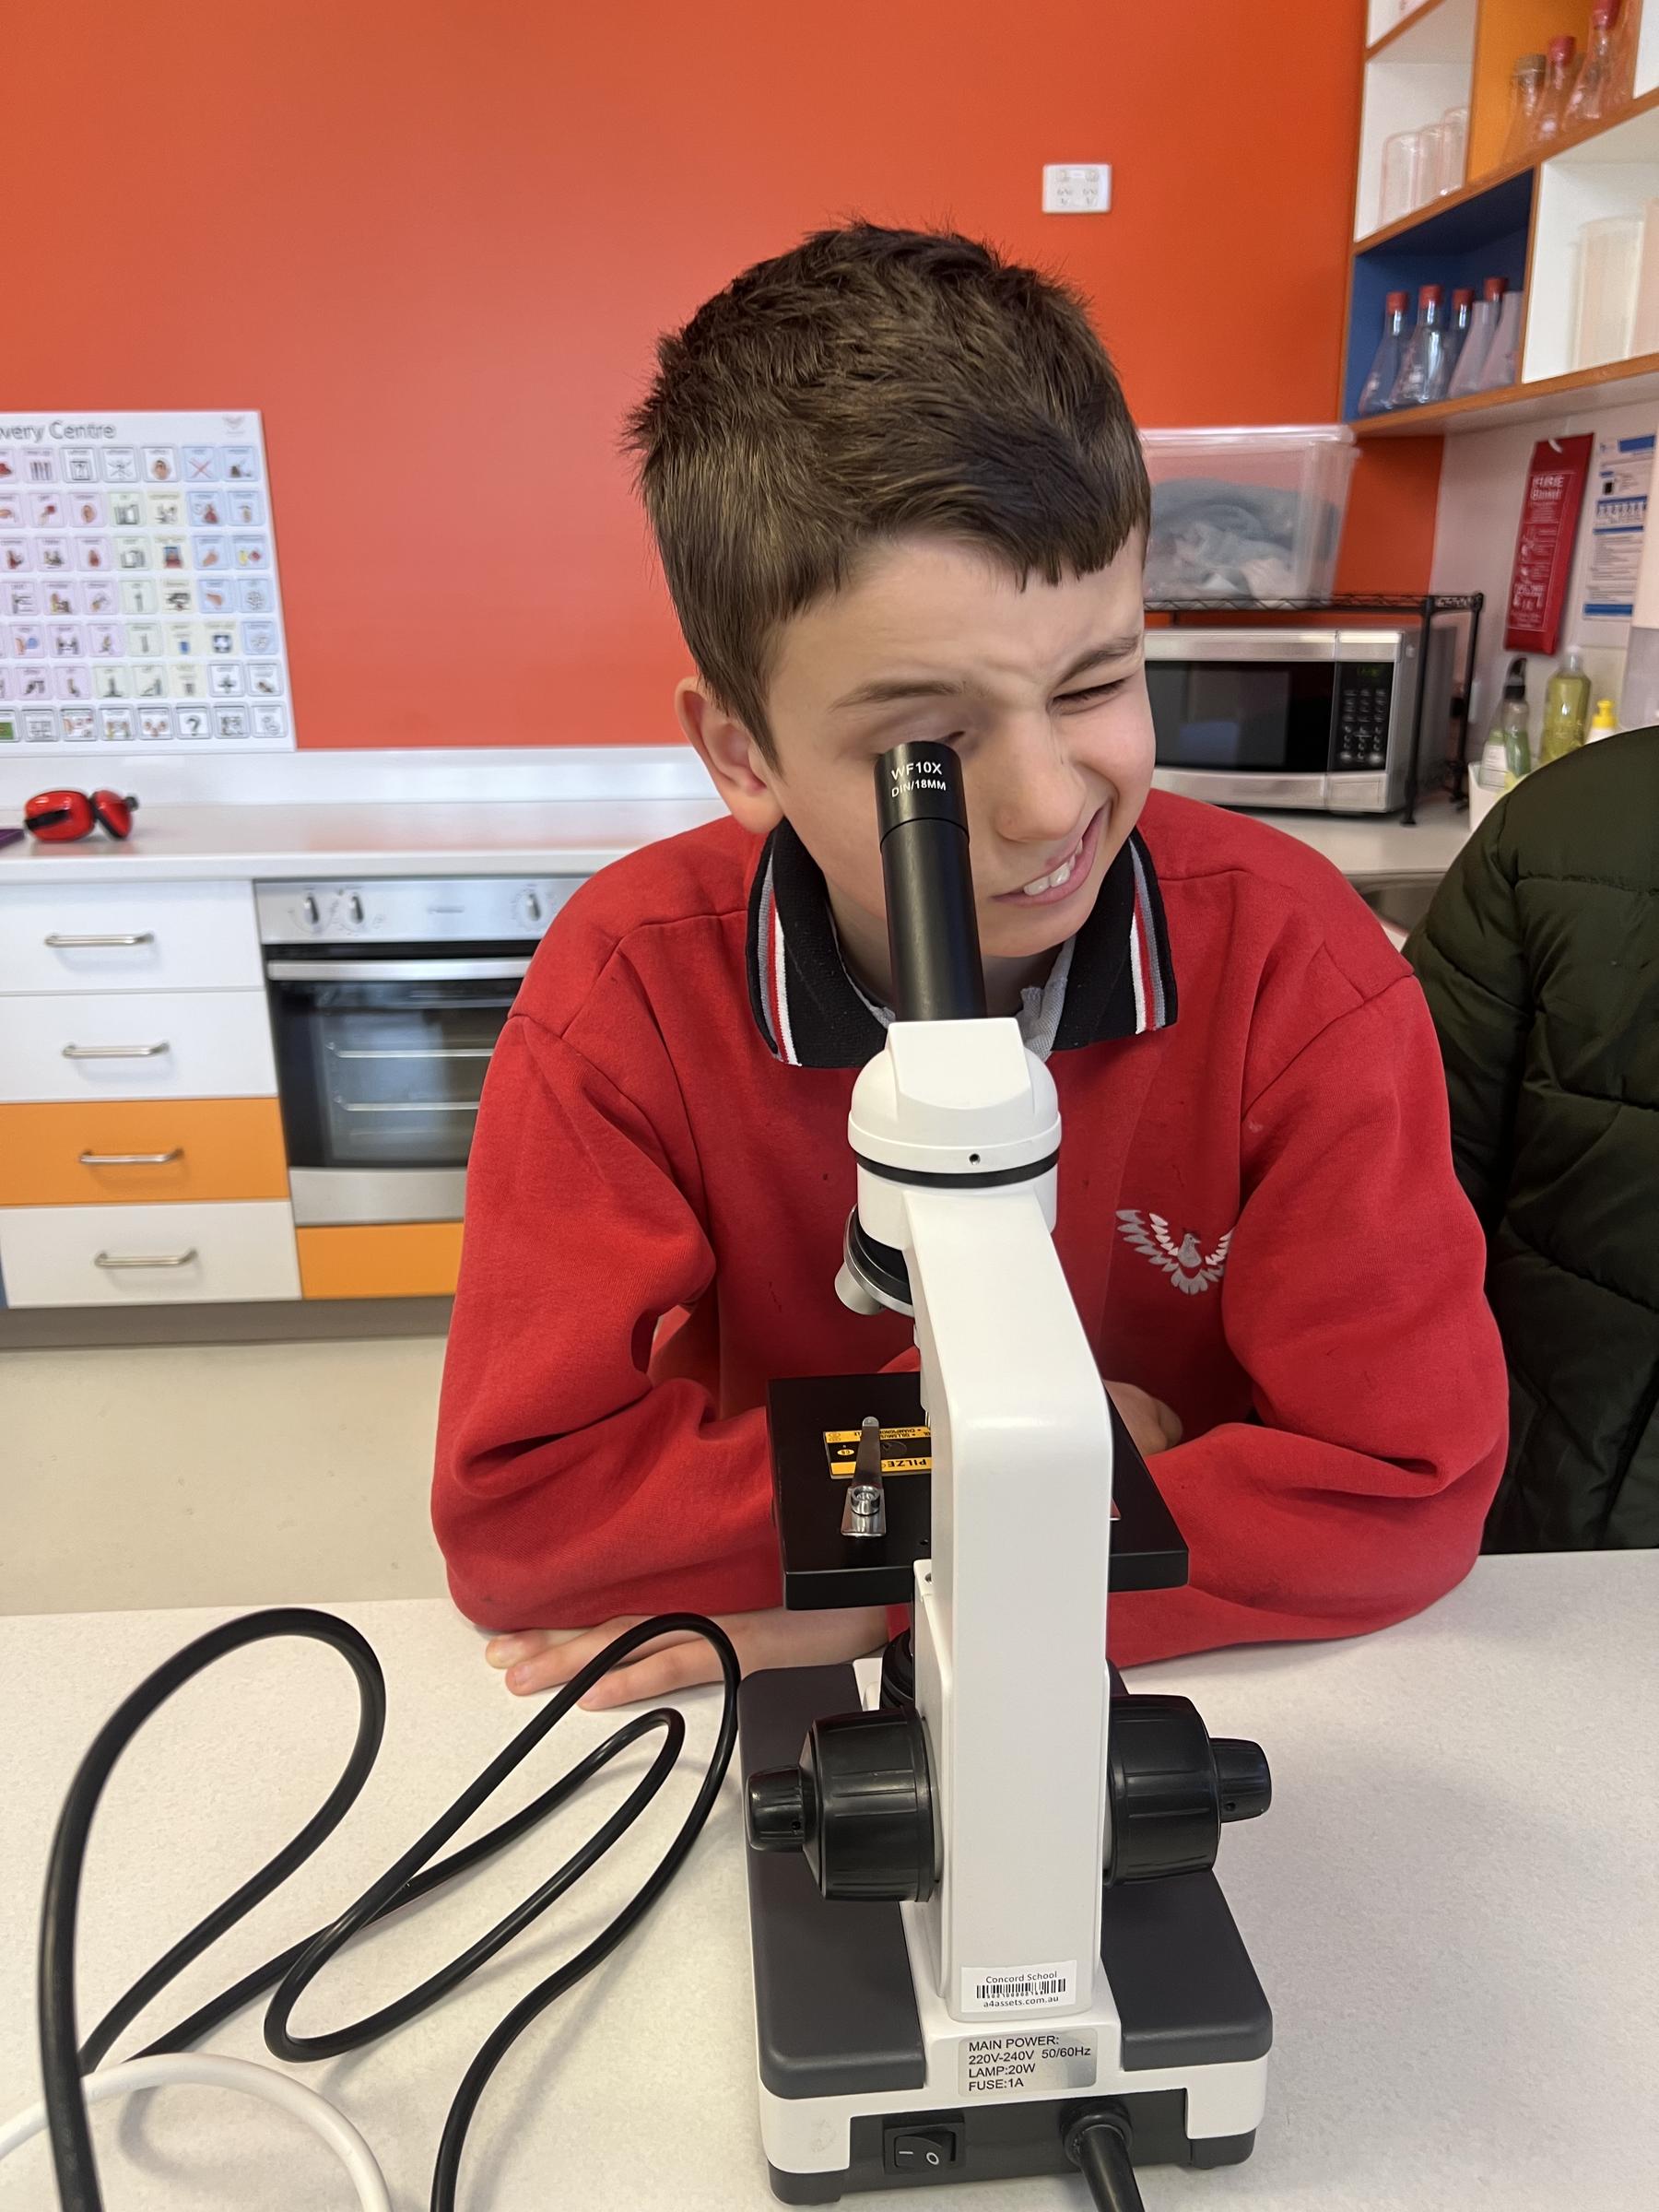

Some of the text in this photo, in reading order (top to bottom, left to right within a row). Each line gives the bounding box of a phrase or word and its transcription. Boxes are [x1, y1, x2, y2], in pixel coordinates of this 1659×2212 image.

[49, 420, 116, 440] Centre
[891, 762, 942, 780] WF10X
[891, 779, 946, 797] DIN/18MM
[888, 1459, 926, 1467] PILZE
[985, 1971, 1057, 1983] Concord School
[983, 1996, 1059, 2007] a4assets.com.au
[969, 2035, 1059, 2052] MAIN POWER:
[969, 2046, 1091, 2065] 220V-240V 50/60Hz
[969, 2064, 1036, 2078] LAMP:20W
[969, 2077, 1024, 2091] FUSE:1A
